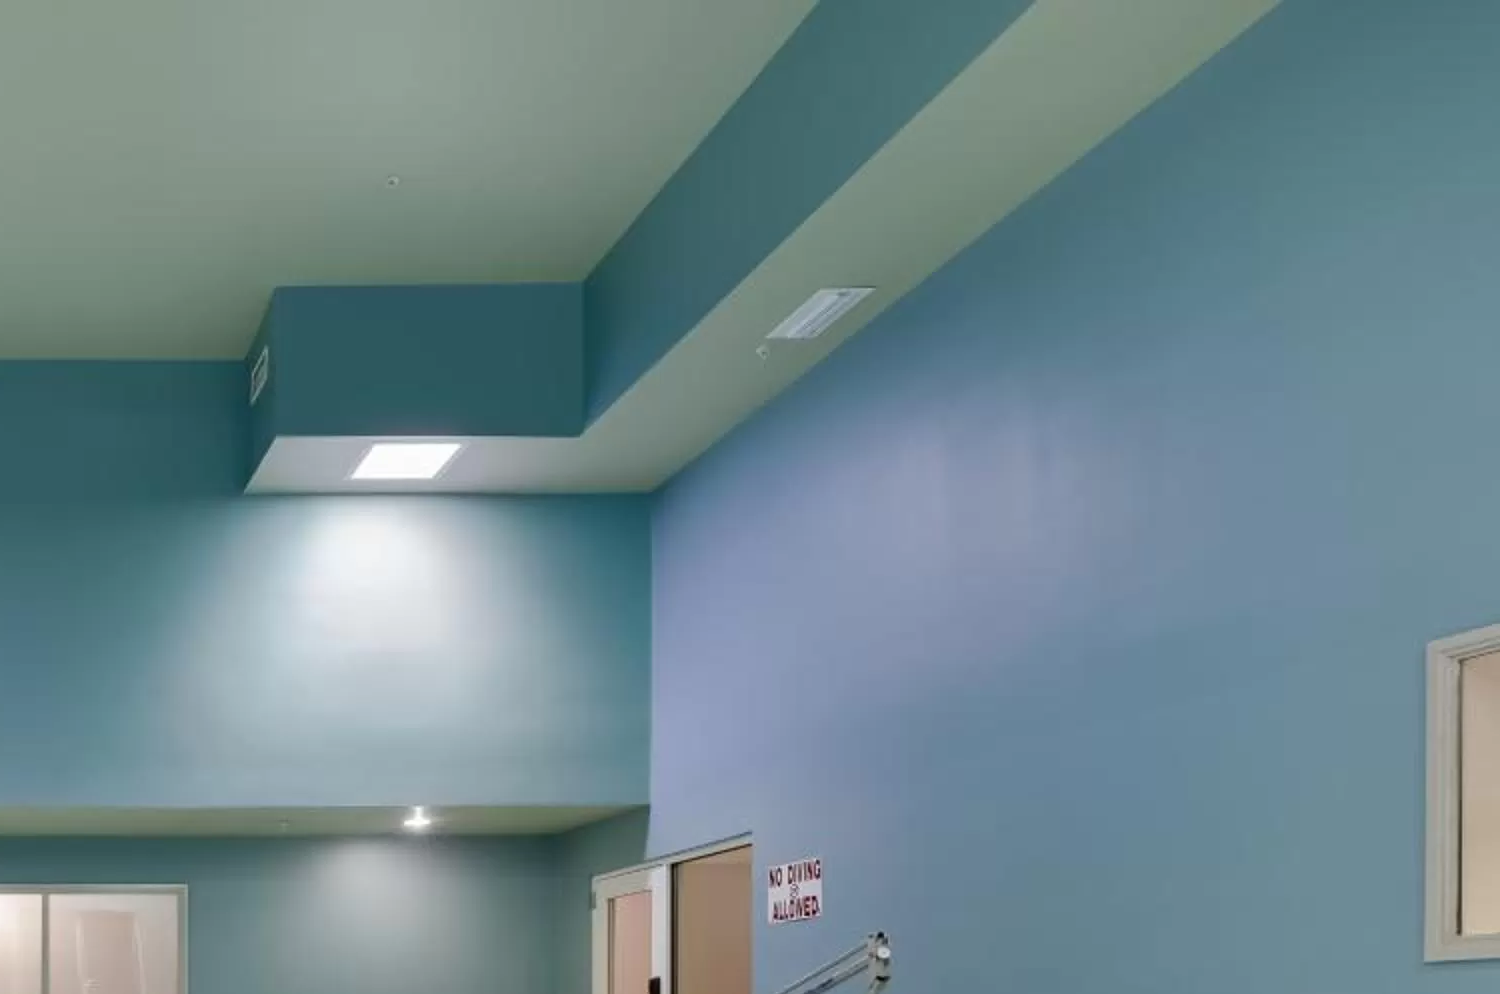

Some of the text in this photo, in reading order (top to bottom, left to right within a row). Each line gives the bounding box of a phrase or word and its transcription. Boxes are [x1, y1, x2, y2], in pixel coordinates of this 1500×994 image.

[768, 859, 821, 888] NO DIVING
[773, 895, 821, 920] ALLOWED
